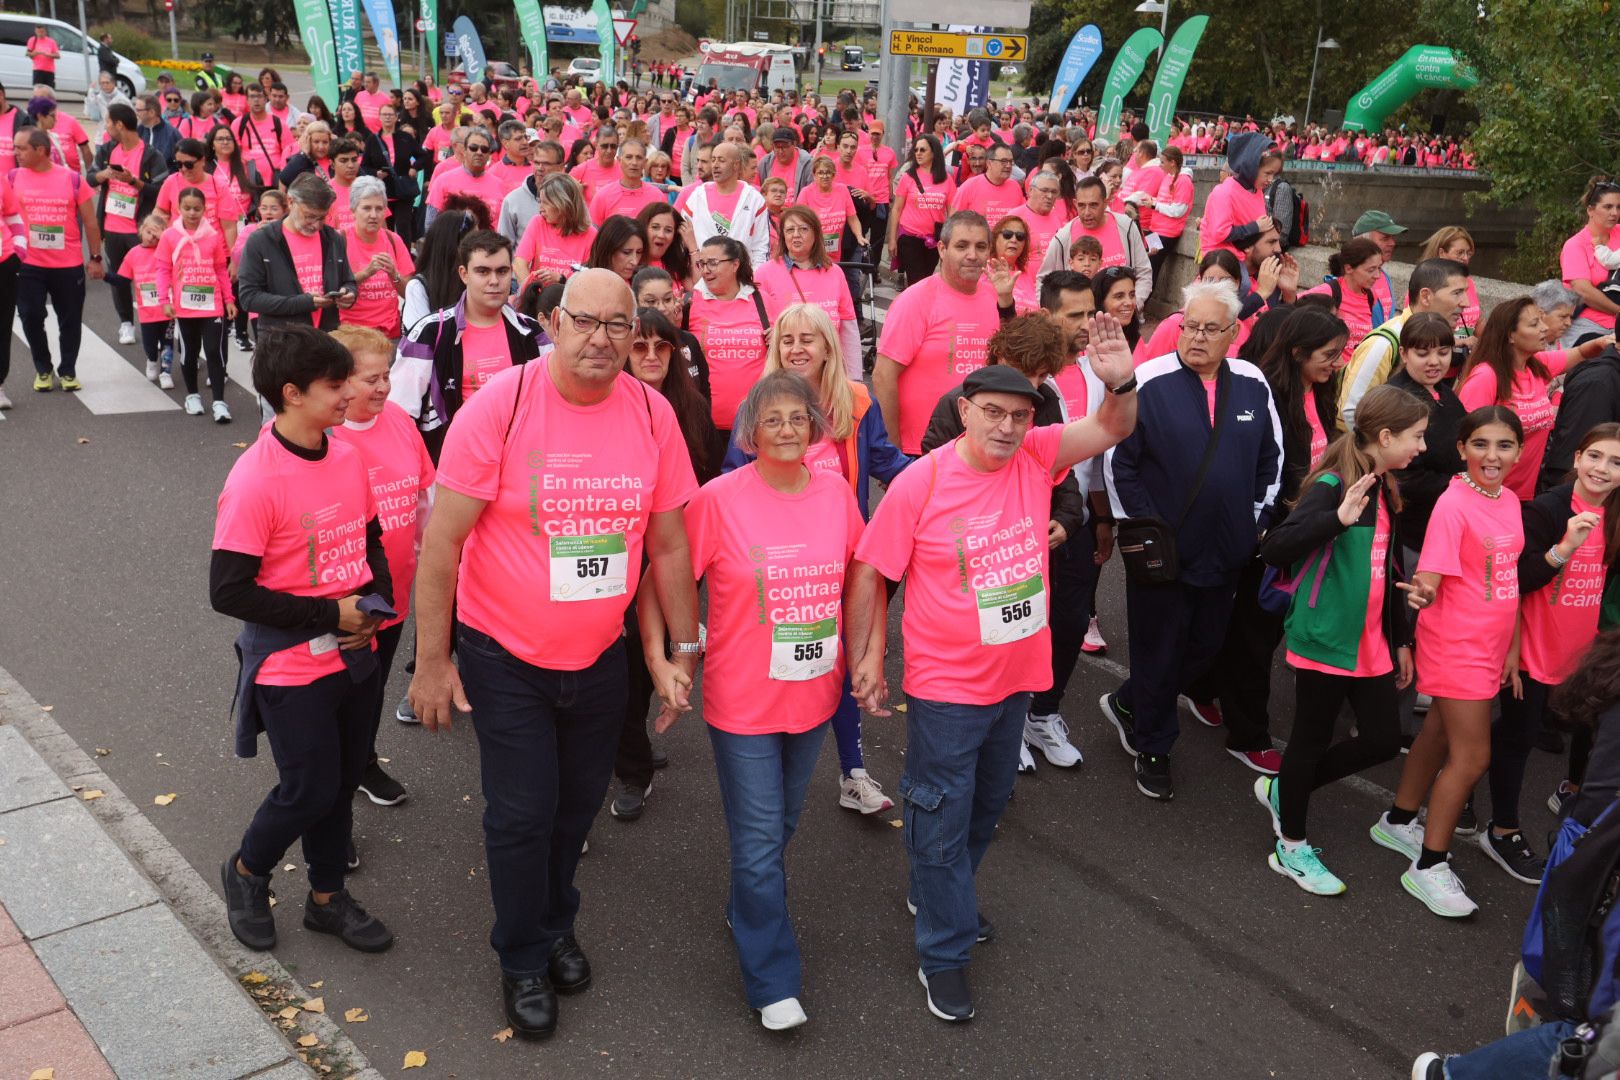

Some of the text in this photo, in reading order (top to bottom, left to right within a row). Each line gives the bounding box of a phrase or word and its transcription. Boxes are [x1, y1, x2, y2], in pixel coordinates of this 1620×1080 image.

[893, 34, 933, 44] H. Vincci
[892, 43, 954, 54] H. P. Romano
[25, 204, 57, 213] contra
[38, 233, 56, 242] 1738
[190, 293, 207, 302] 1739
[707, 326, 721, 335] En
[706, 336, 761, 347] contra el
[956, 335, 969, 345] En
[707, 346, 761, 359] cáncer
[543, 474, 643, 490] En marcha
[542, 493, 642, 513] contra el
[543, 513, 641, 537] cáncer
[317, 529, 334, 545] En
[967, 535, 989, 550] En
[970, 532, 1039, 569] contra el
[576, 557, 609, 578] 557
[767, 560, 844, 580] En marcha
[971, 552, 1043, 590] cáncer
[1570, 560, 1588, 573] En
[768, 582, 829, 601] contra
[770, 599, 841, 624] cáncer
[1001, 600, 1032, 624] 556
[794, 641, 823, 662] 555
